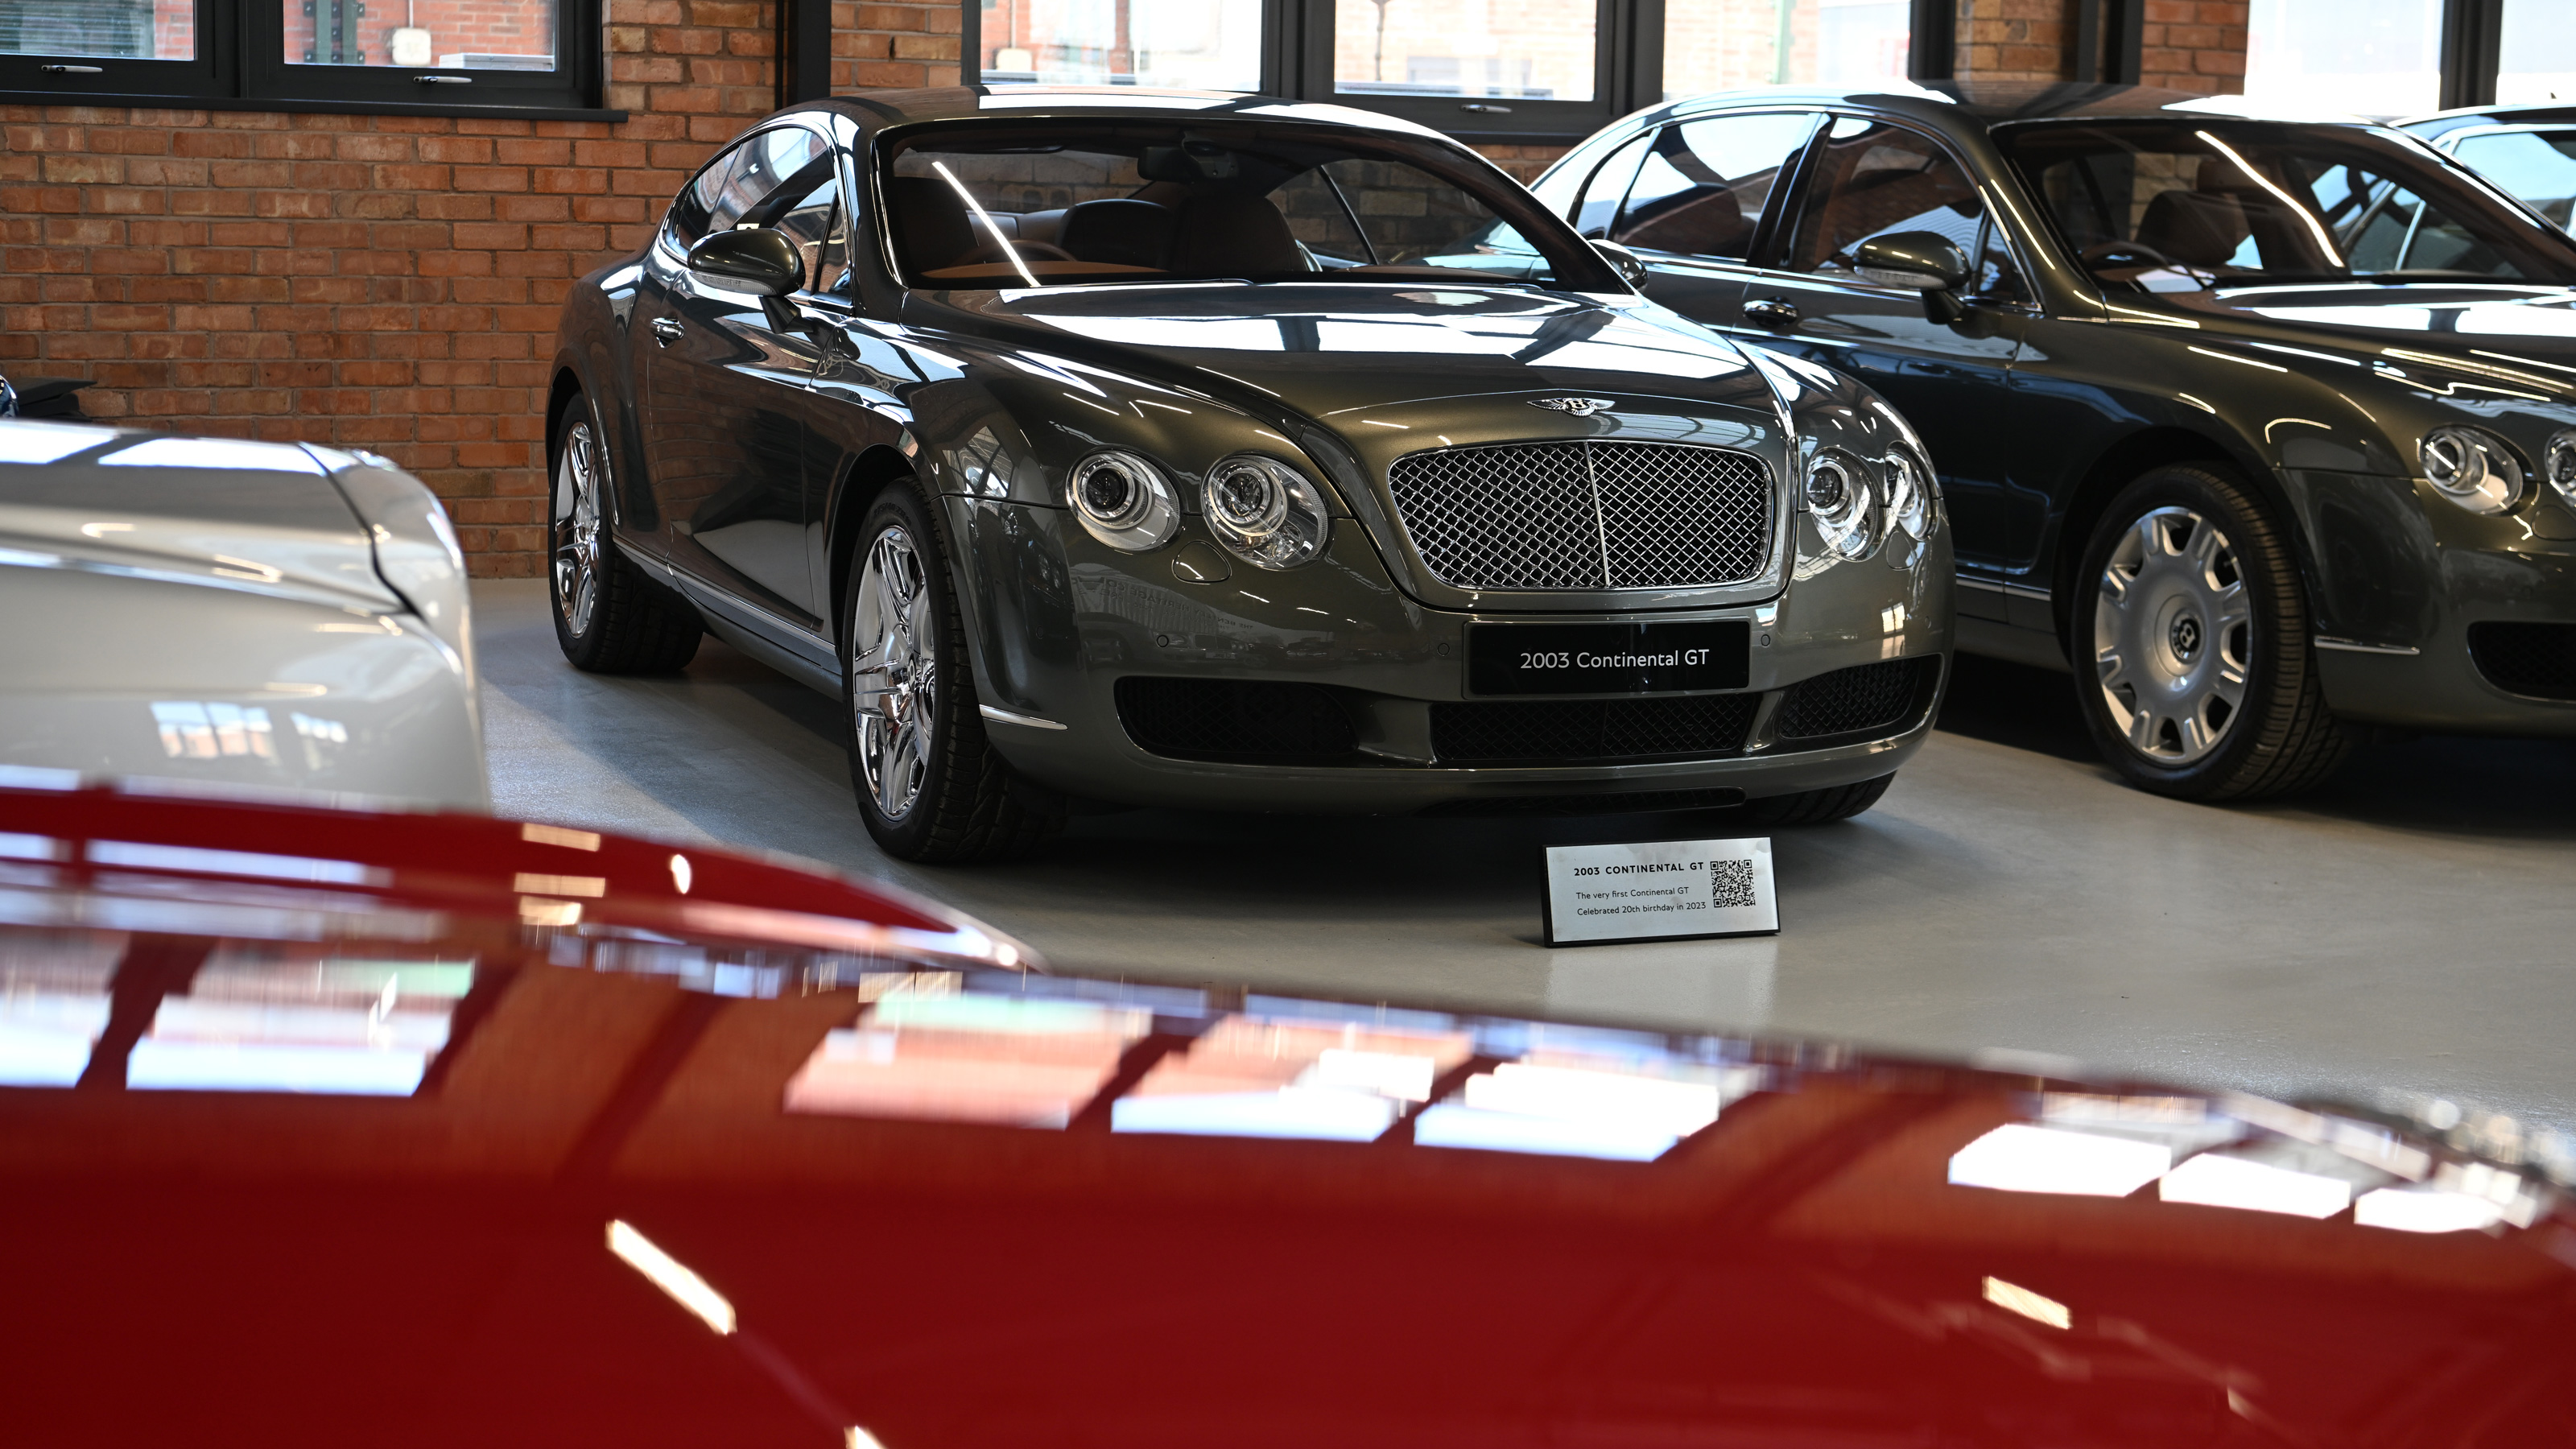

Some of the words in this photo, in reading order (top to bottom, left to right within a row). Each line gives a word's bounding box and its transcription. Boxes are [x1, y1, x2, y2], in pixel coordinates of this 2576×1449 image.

[1520, 652, 1570, 669] 2003
[1576, 650, 1678, 668] Continental
[1684, 649, 1710, 665] GT
[1574, 867, 1600, 876] 2003
[1605, 863, 1685, 874] CONTINENTAL
[1690, 862, 1704, 870] GT
[1575, 892, 1591, 900] The
[1592, 892, 1610, 900] very
[1612, 890, 1629, 898] first
[1630, 888, 1675, 898] Continental
[1677, 886, 1689, 894] GT
[1577, 906, 1620, 916] Celebrated
[1621, 905, 1641, 914] 20th
[1642, 903, 1674, 913] birthday
[1676, 903, 1684, 911] in
[1686, 902, 1707, 910] 2023
